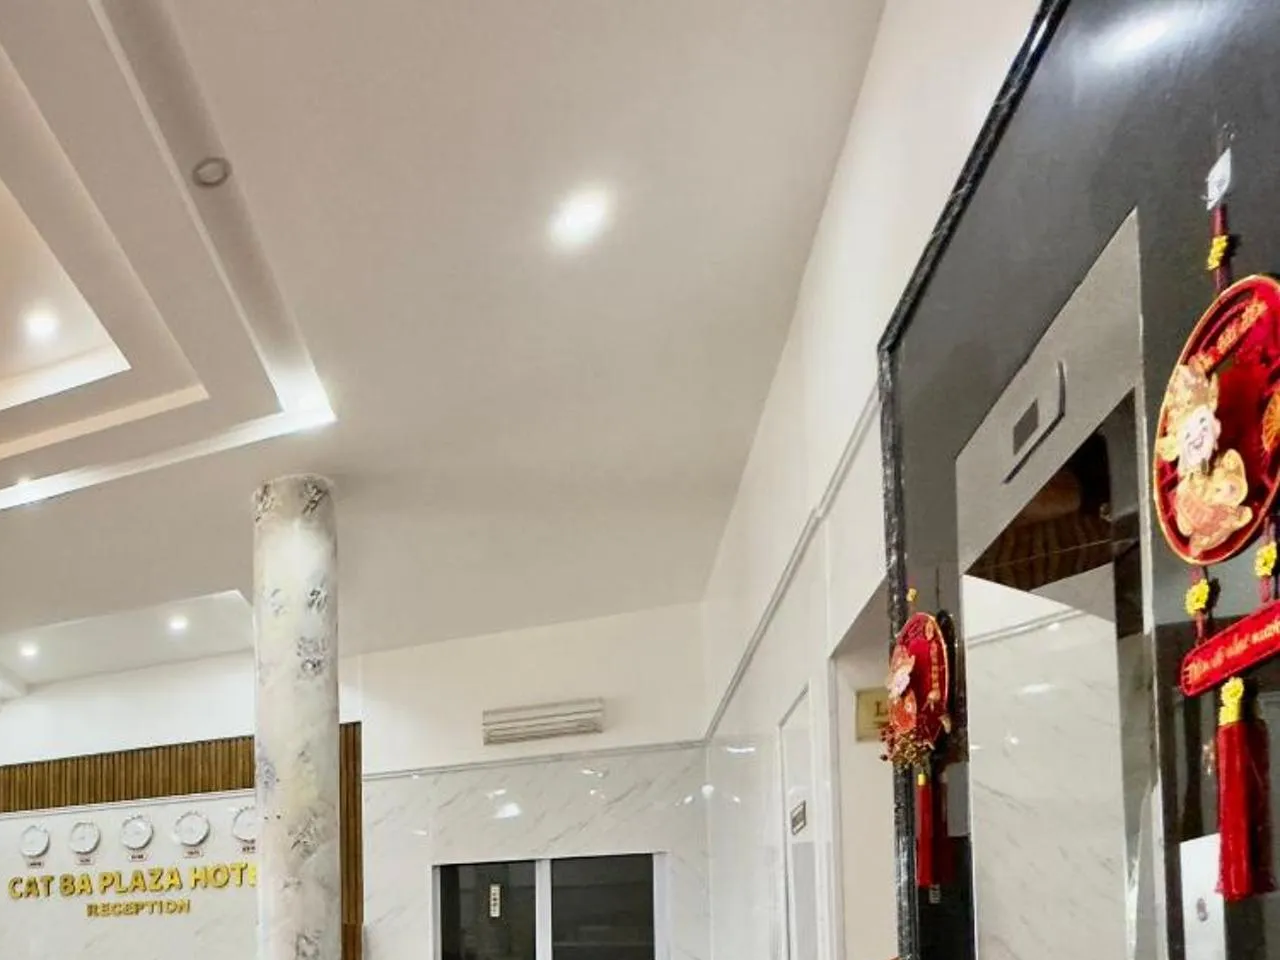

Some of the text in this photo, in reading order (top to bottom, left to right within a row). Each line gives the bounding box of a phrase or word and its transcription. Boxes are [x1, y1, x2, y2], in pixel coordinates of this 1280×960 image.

[8, 875, 55, 899] CAT
[59, 873, 93, 896] BA
[98, 867, 183, 895] PLAZA
[86, 899, 191, 917] RECEPTION
